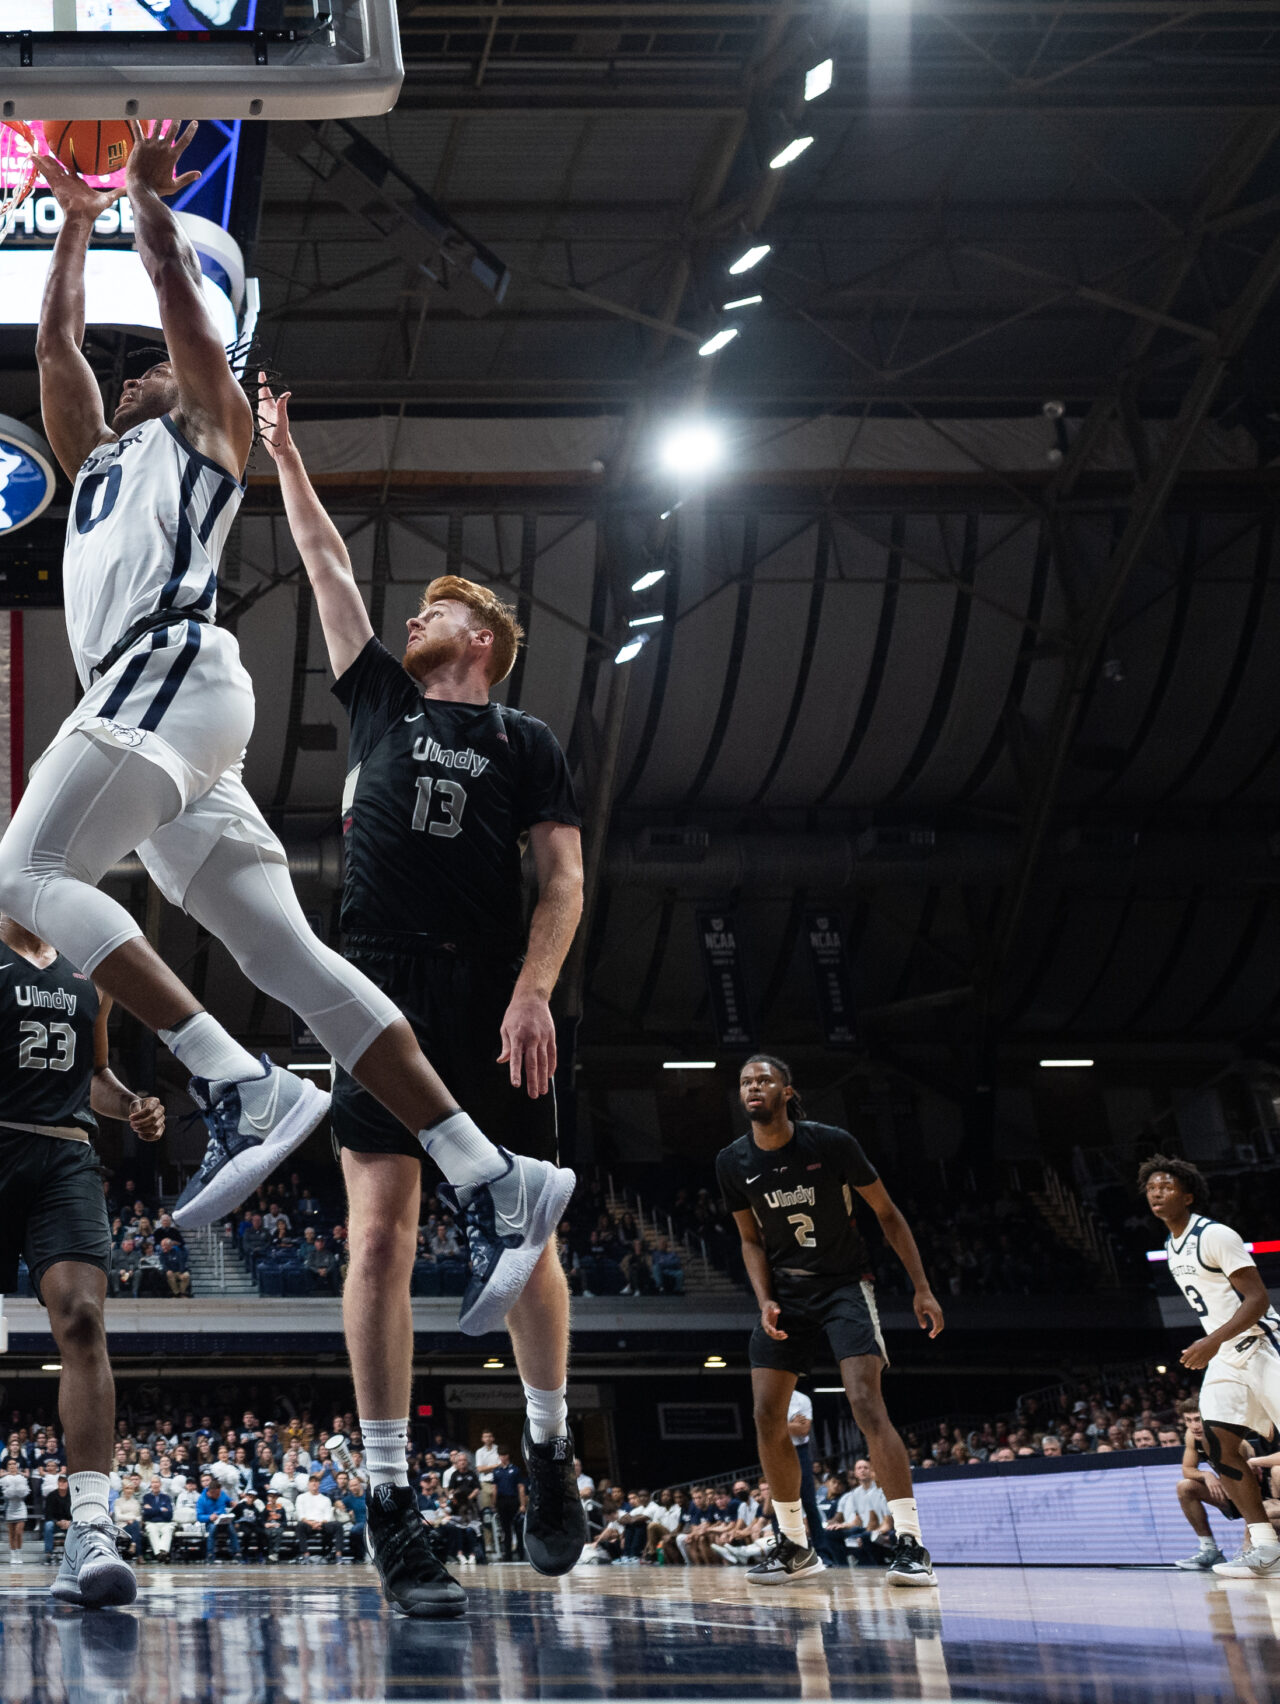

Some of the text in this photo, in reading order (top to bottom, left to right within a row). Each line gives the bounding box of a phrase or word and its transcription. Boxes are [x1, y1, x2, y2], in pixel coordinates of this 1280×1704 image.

[75, 464, 123, 535] 0
[412, 736, 490, 778] UIndy
[411, 776, 468, 839] 13
[704, 932, 736, 949] NCAA
[14, 985, 77, 1016] UIndy
[18, 1020, 77, 1072] 23
[763, 1184, 816, 1209] UIndy
[786, 1212, 817, 1248] 2
[1184, 1284, 1209, 1318] 3
